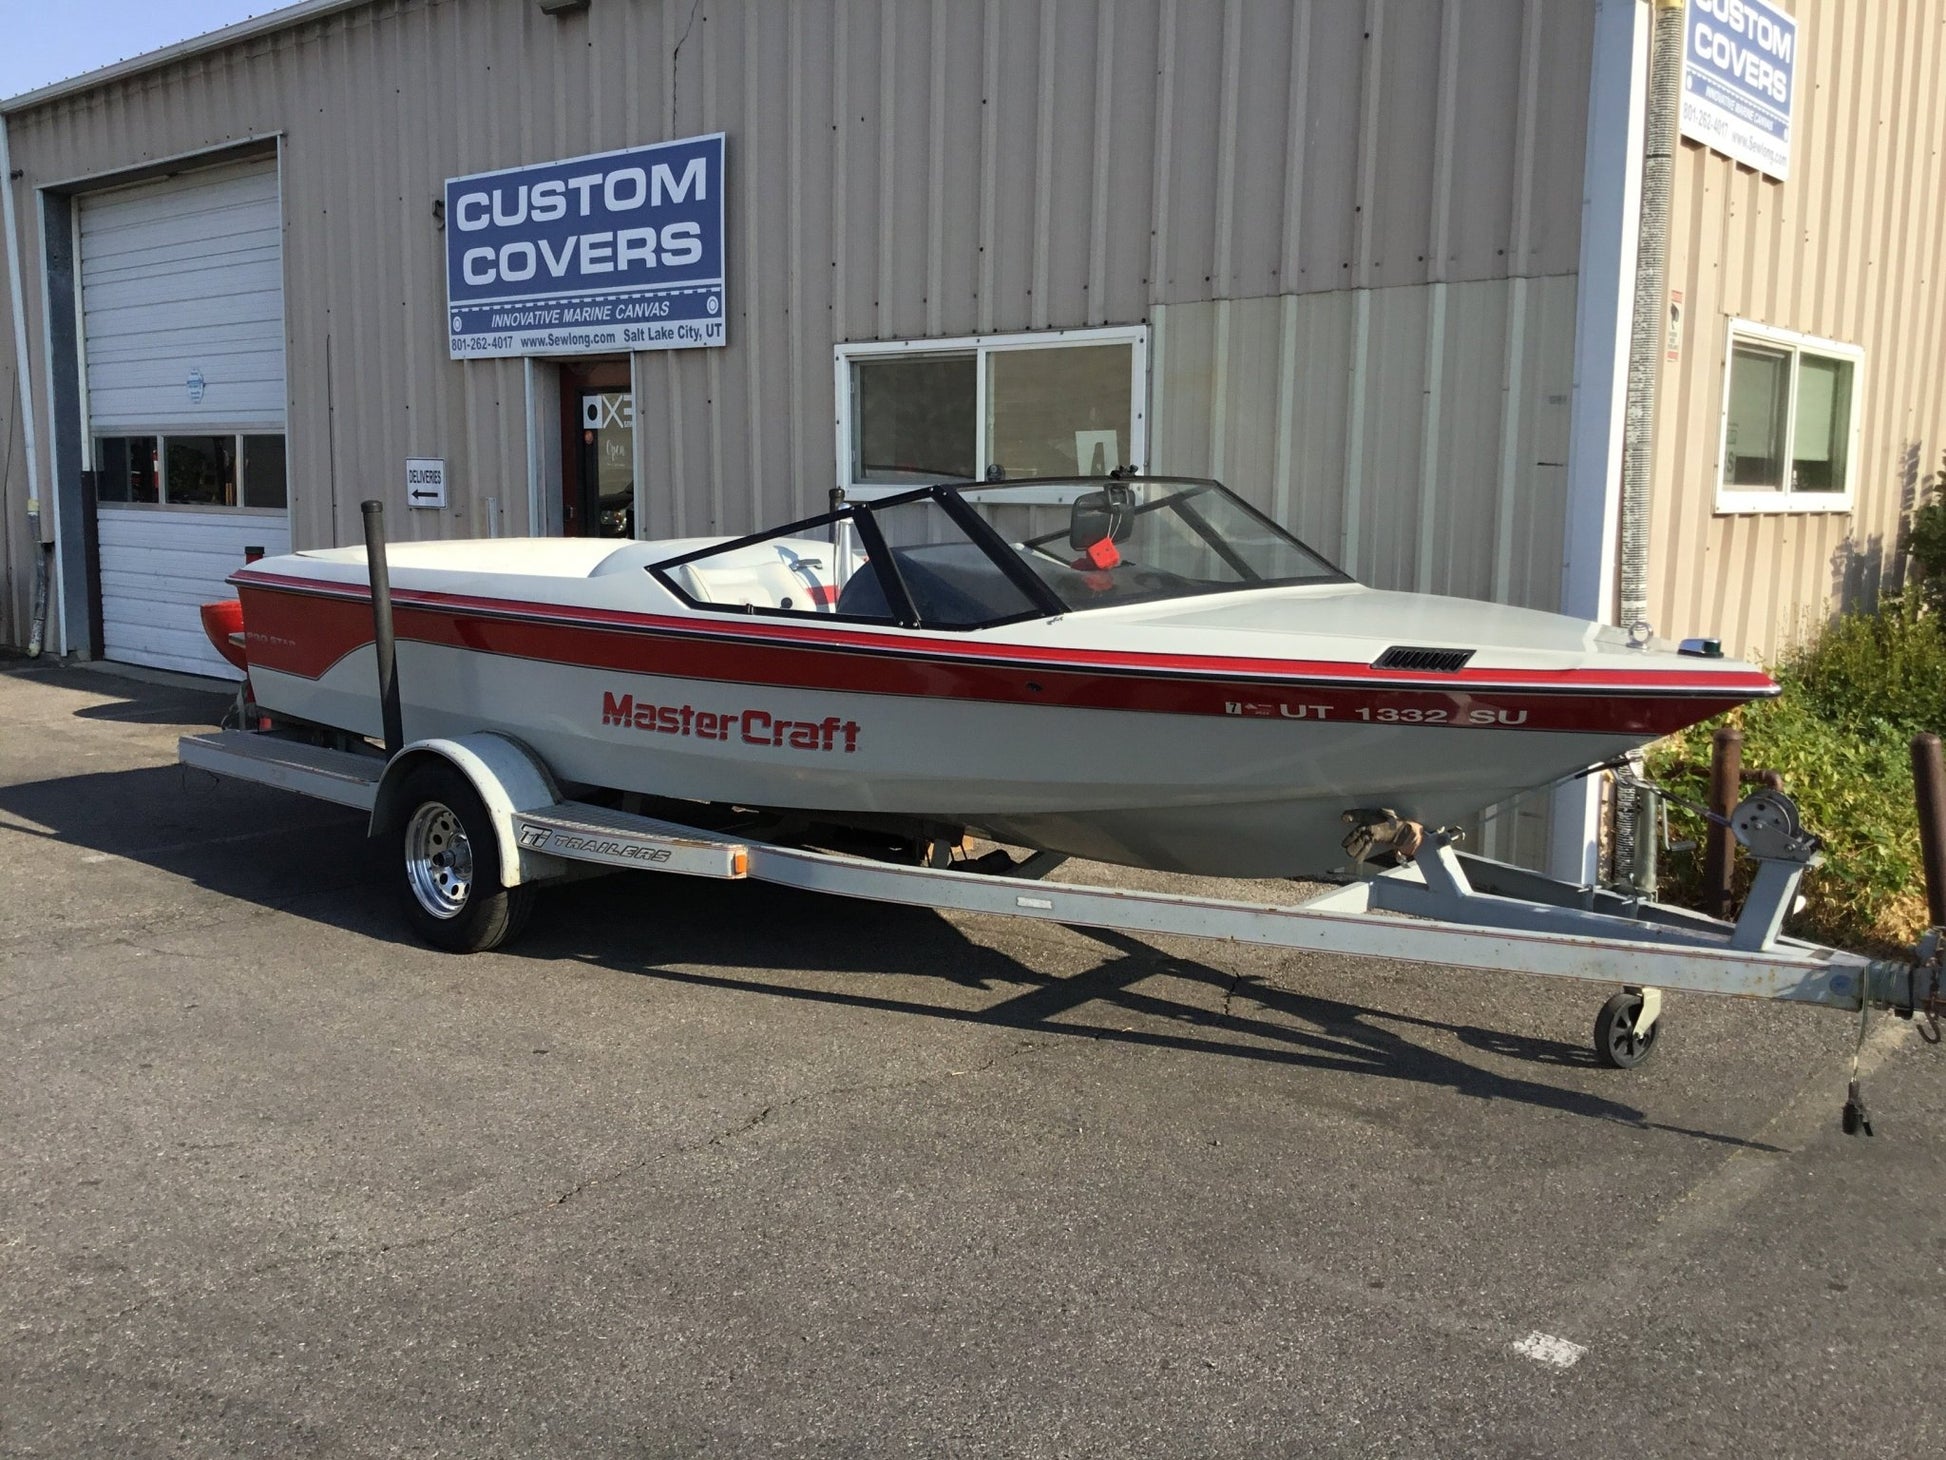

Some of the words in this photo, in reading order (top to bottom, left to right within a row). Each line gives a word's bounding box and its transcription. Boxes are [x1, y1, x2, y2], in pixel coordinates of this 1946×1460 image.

[1694, 23, 1787, 103] COVERS
[456, 157, 707, 232] CUSTOM
[463, 221, 703, 286] COVERS
[491, 309, 561, 328] INNOVATIVE
[562, 305, 612, 323] MARINE
[615, 301, 670, 319] CANVAS
[452, 336, 513, 351] 801-262-4017
[520, 331, 616, 348] www.Sewlong.com
[623, 327, 645, 343] Salt
[648, 325, 675, 340] Lake
[677, 324, 703, 341] City,
[705, 323, 723, 338] UT
[409, 469, 442, 484] DELIVERIES
[602, 691, 861, 753] MasterCraft
[1280, 703, 1334, 719] UT
[1355, 707, 1448, 723] 1332
[1469, 709, 1528, 725] SU
[554, 834, 672, 863] TRAILERS
